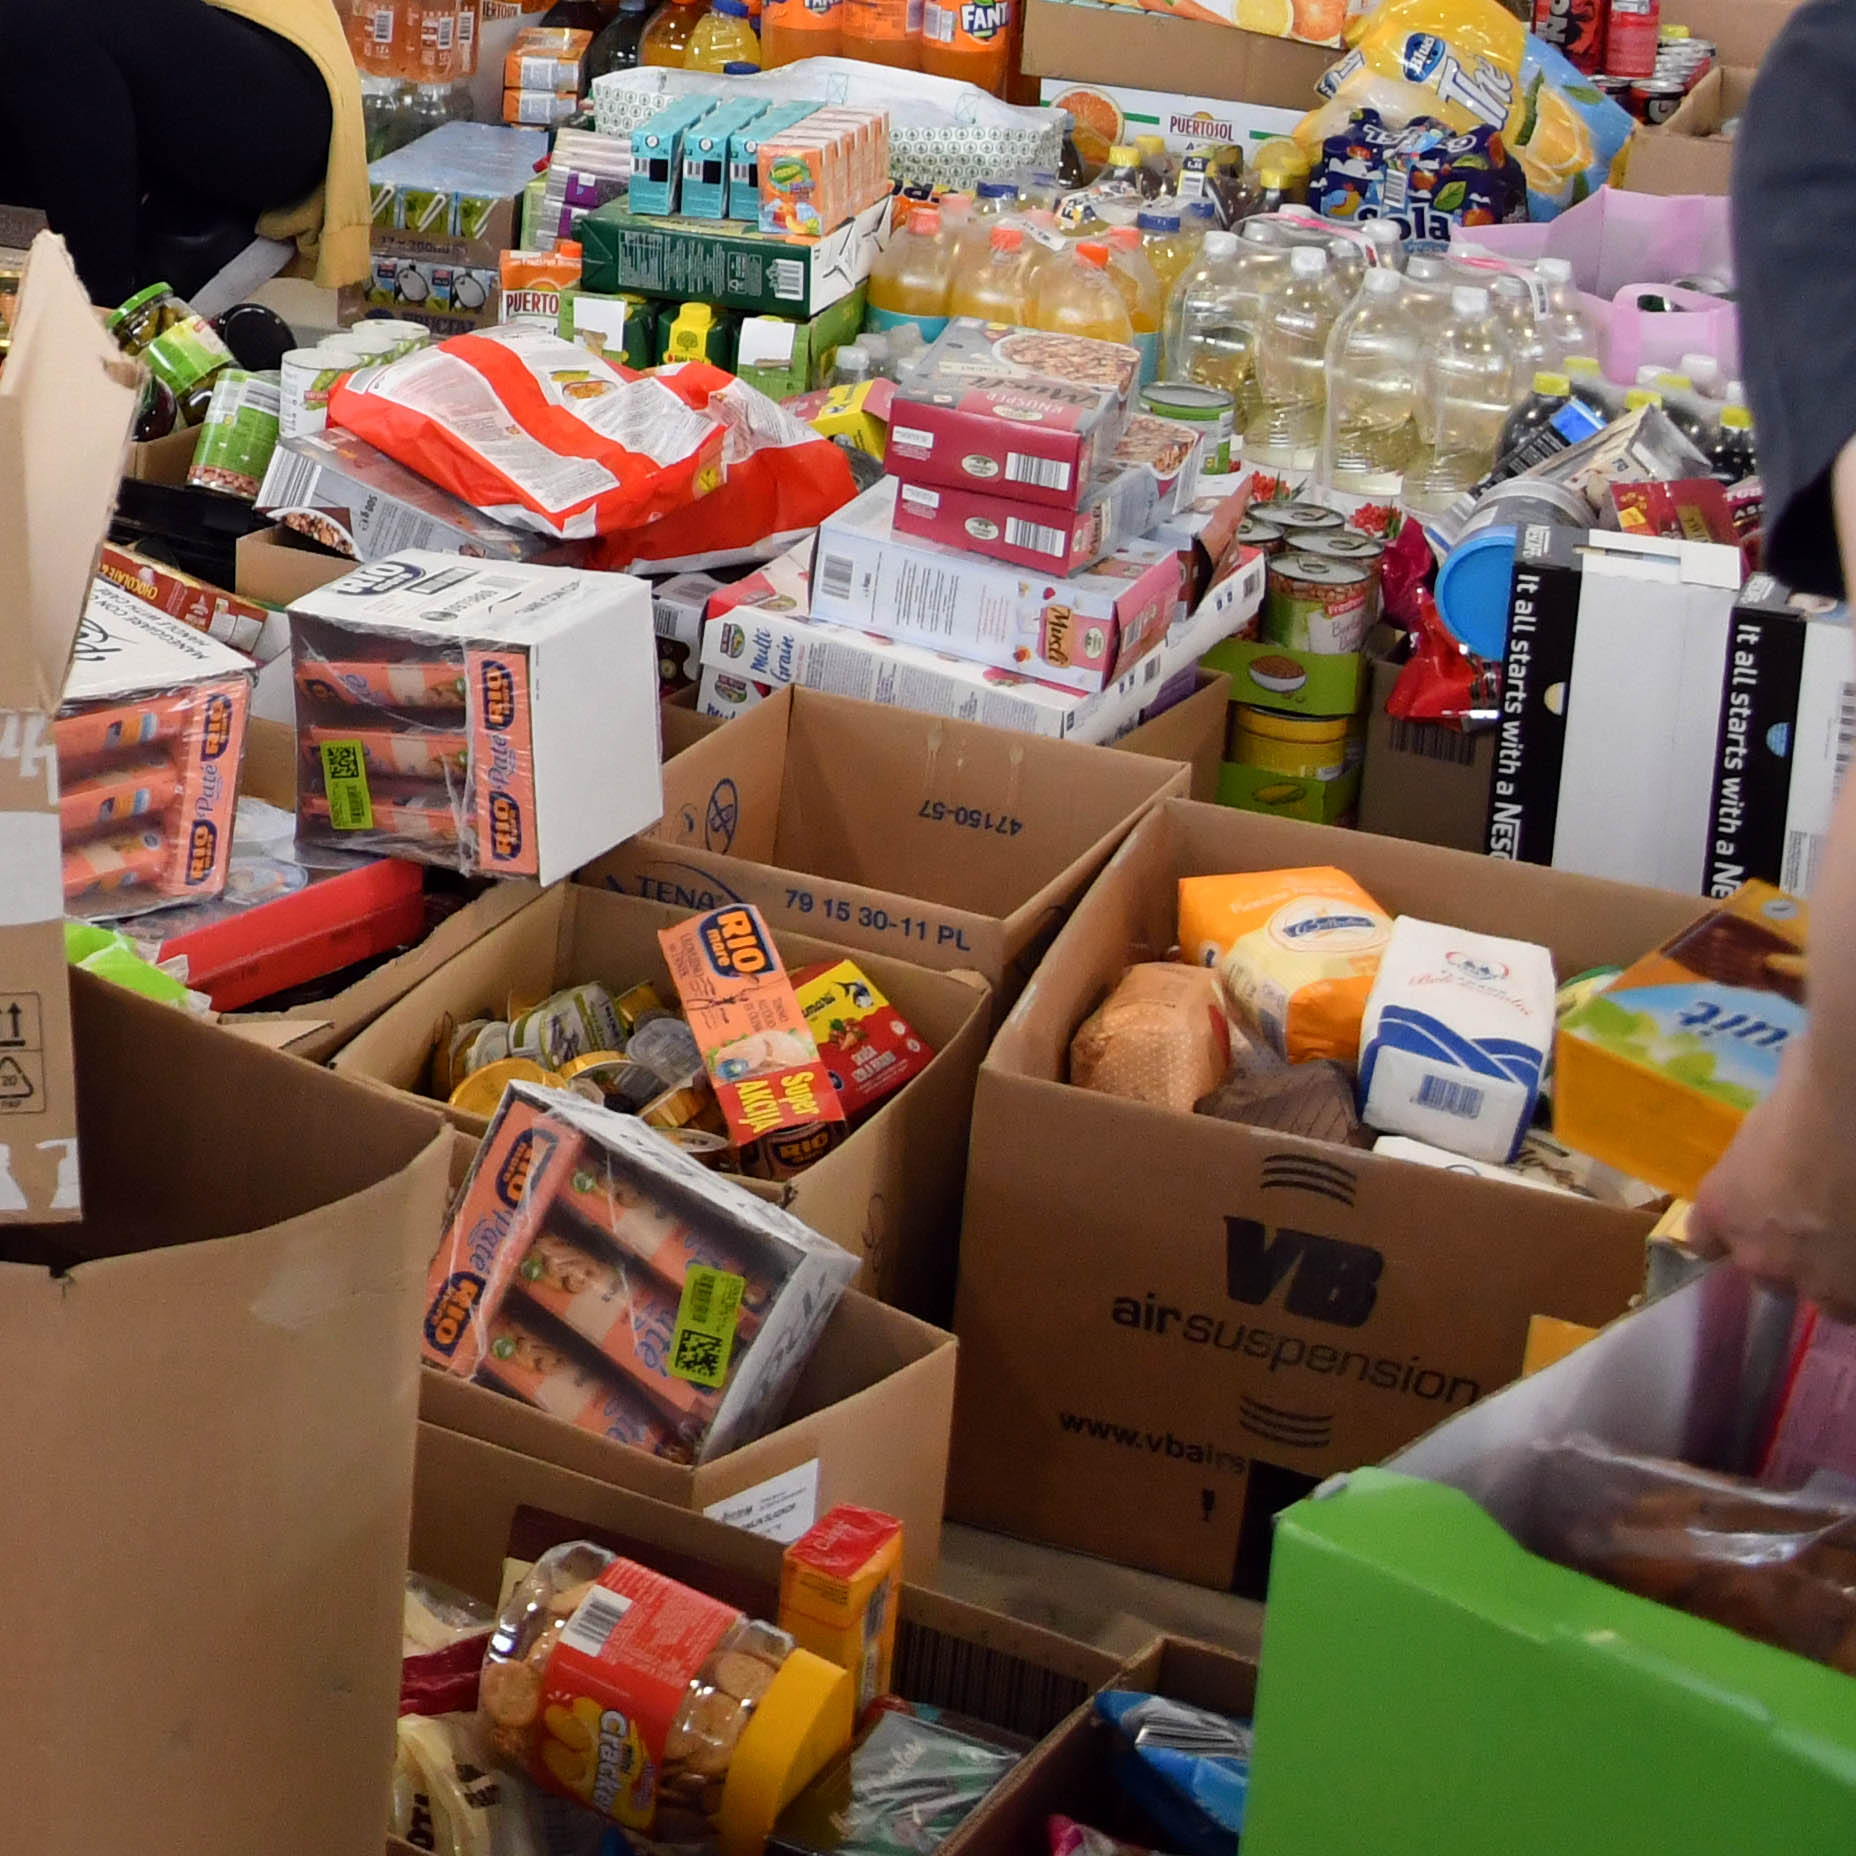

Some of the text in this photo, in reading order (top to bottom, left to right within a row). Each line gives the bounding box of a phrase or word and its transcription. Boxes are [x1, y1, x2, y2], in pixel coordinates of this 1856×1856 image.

[1168, 114, 1235, 143] PUERTOSOL
[505, 292, 560, 315] PUERTO
[109, 567, 159, 601] CHOCOLATE
[1515, 574, 1540, 594] It
[1513, 600, 1537, 633] all
[754, 624, 771, 678] Multi
[772, 632, 795, 684] Grain
[1503, 637, 1531, 714] starts
[485, 667, 506, 726] RIO
[205, 701, 226, 757] RIO
[1497, 718, 1522, 775] with
[1495, 781, 1514, 795] a
[1710, 623, 1762, 899] It all starts with a NE
[491, 798, 513, 855] RIO
[918, 798, 1023, 837] 47150-57
[190, 825, 212, 883] RIO
[637, 875, 717, 910] TENA
[704, 926, 732, 966] mare
[718, 909, 766, 975] RIO
[785, 889, 972, 952] 79 15 30-11 PL
[738, 1078, 777, 1135] AKCIJA
[781, 1072, 819, 1119] Super
[1224, 1215, 1386, 1329] VB
[1058, 1407, 1248, 1476] www.vbairs
